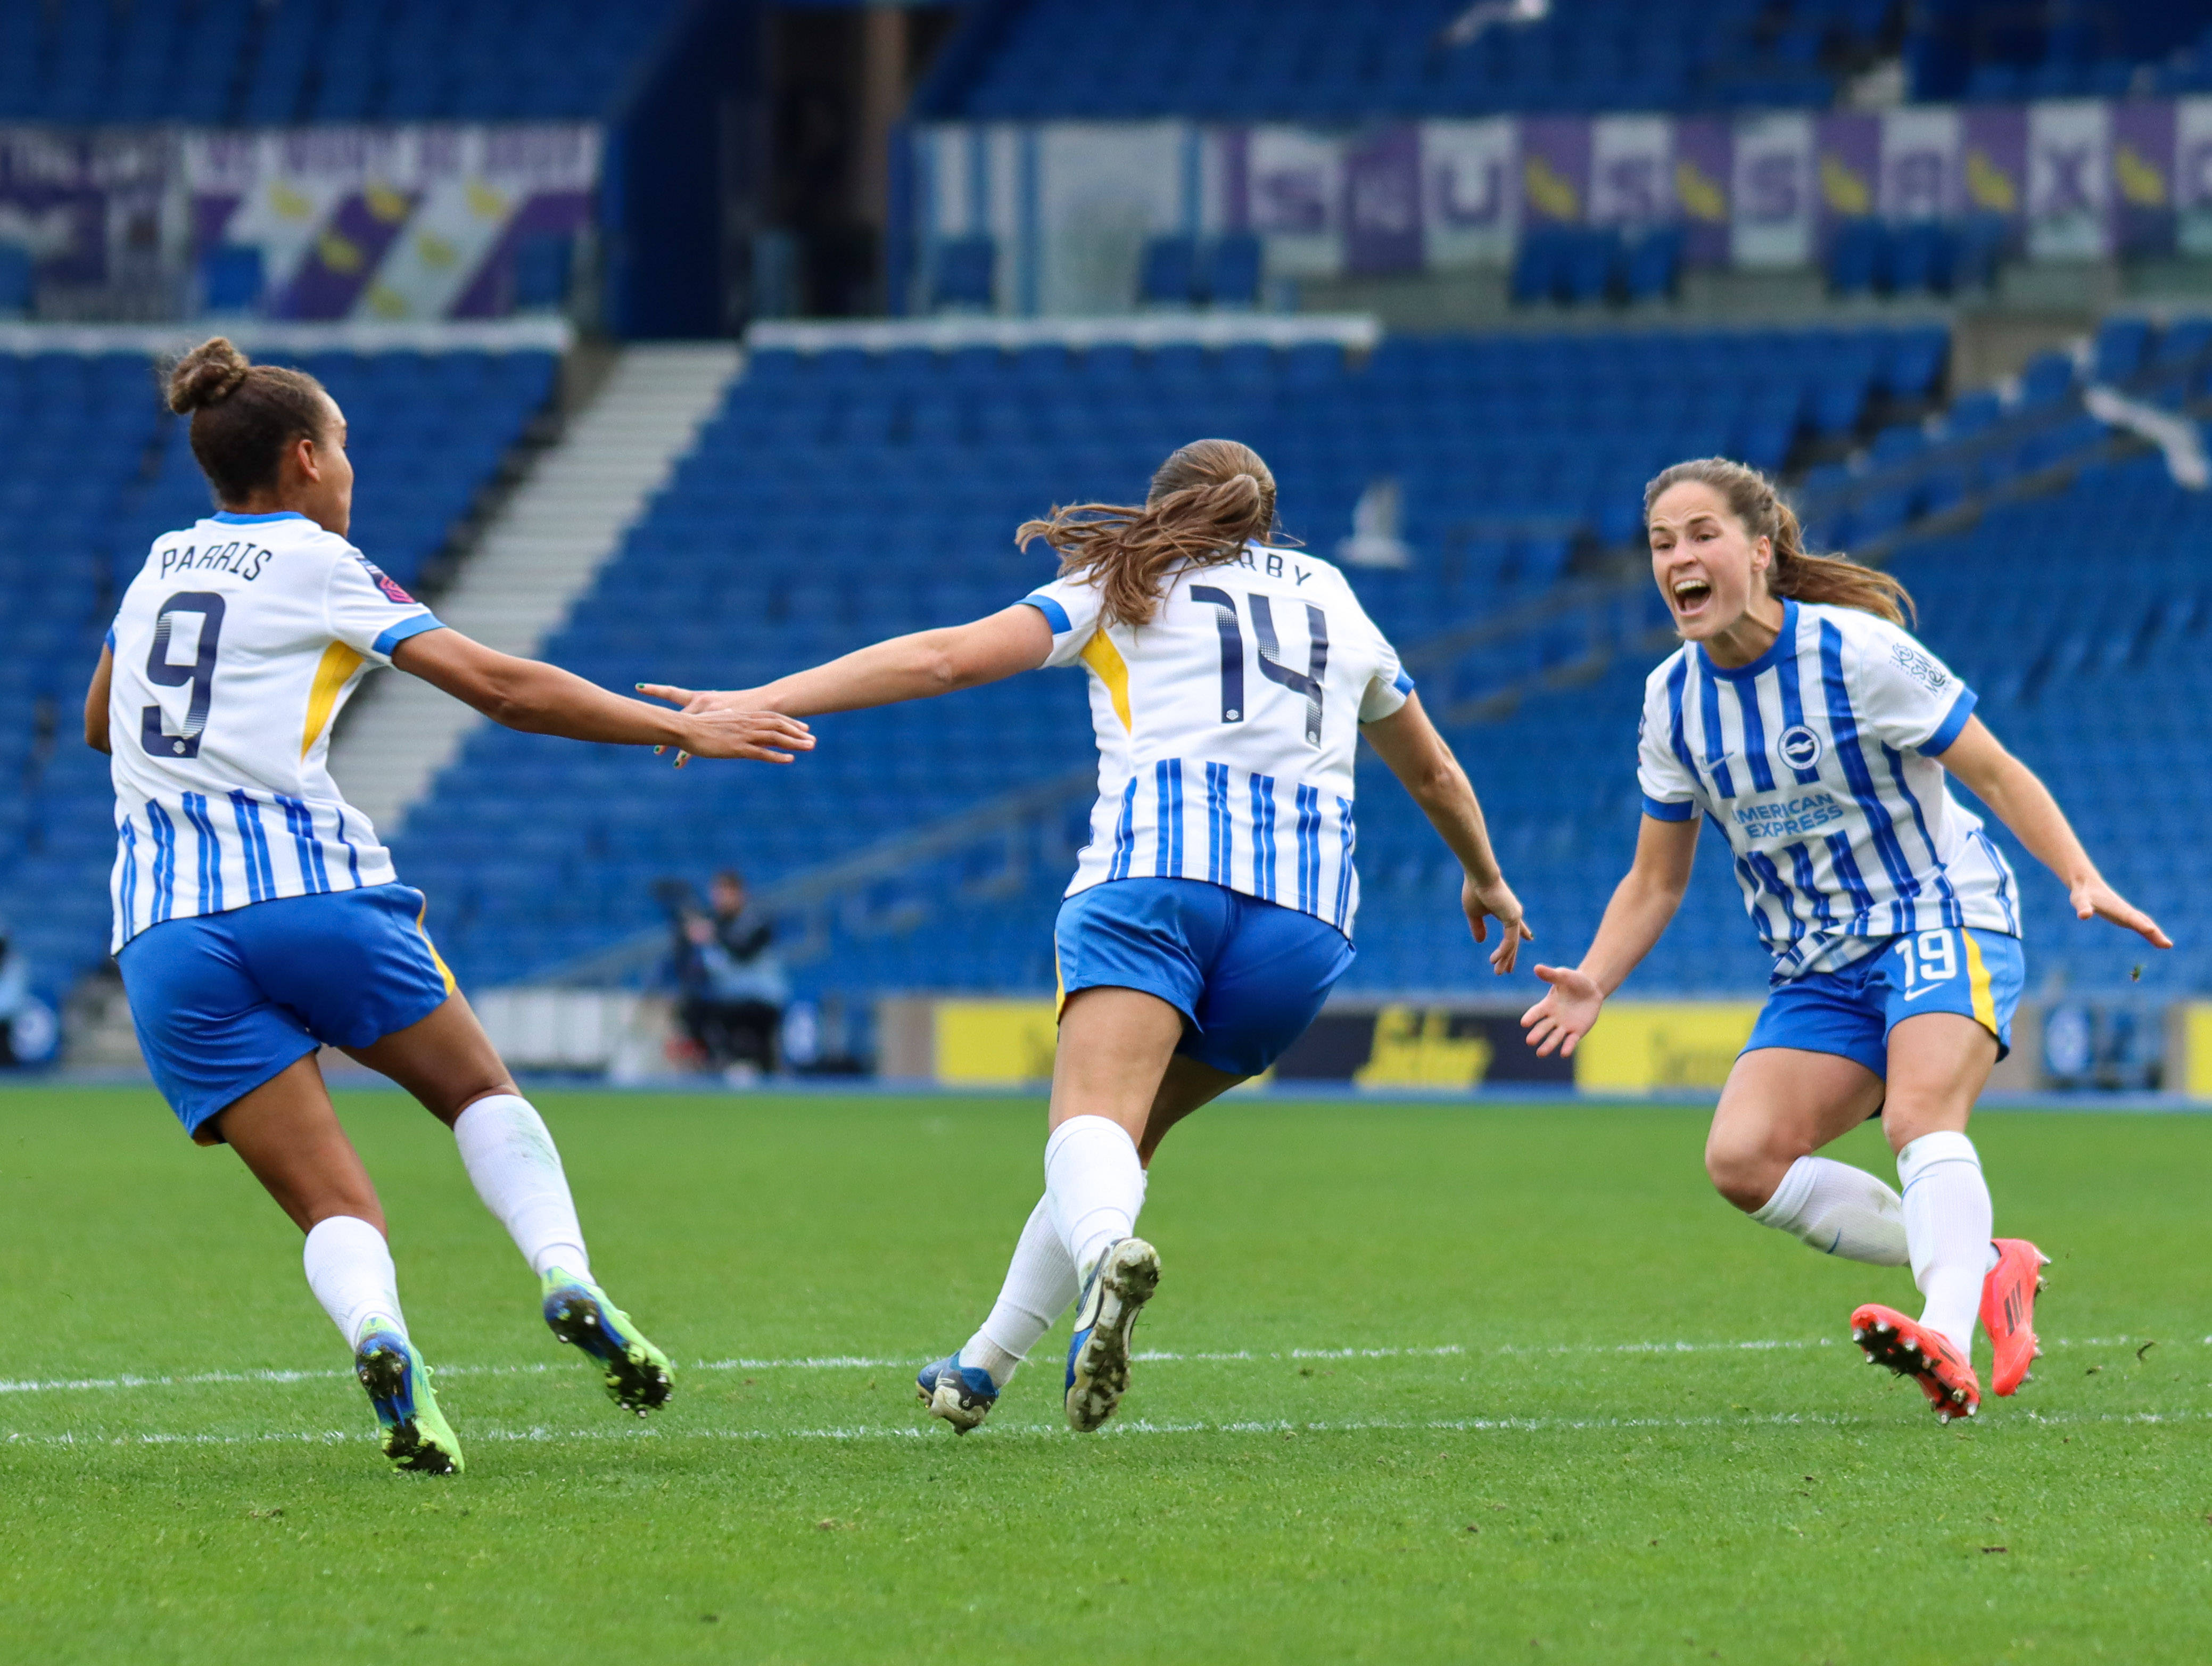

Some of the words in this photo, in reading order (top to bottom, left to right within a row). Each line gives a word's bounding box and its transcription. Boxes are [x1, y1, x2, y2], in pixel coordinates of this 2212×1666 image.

[160, 541, 272, 581] PARRIS
[1207, 548, 1312, 587] RBY
[141, 591, 227, 758] 9
[1189, 584, 1328, 750] 14
[1733, 793, 1834, 824] MERICAN
[1745, 805, 1844, 838] EXPRESS
[1894, 928, 1957, 988] 19
